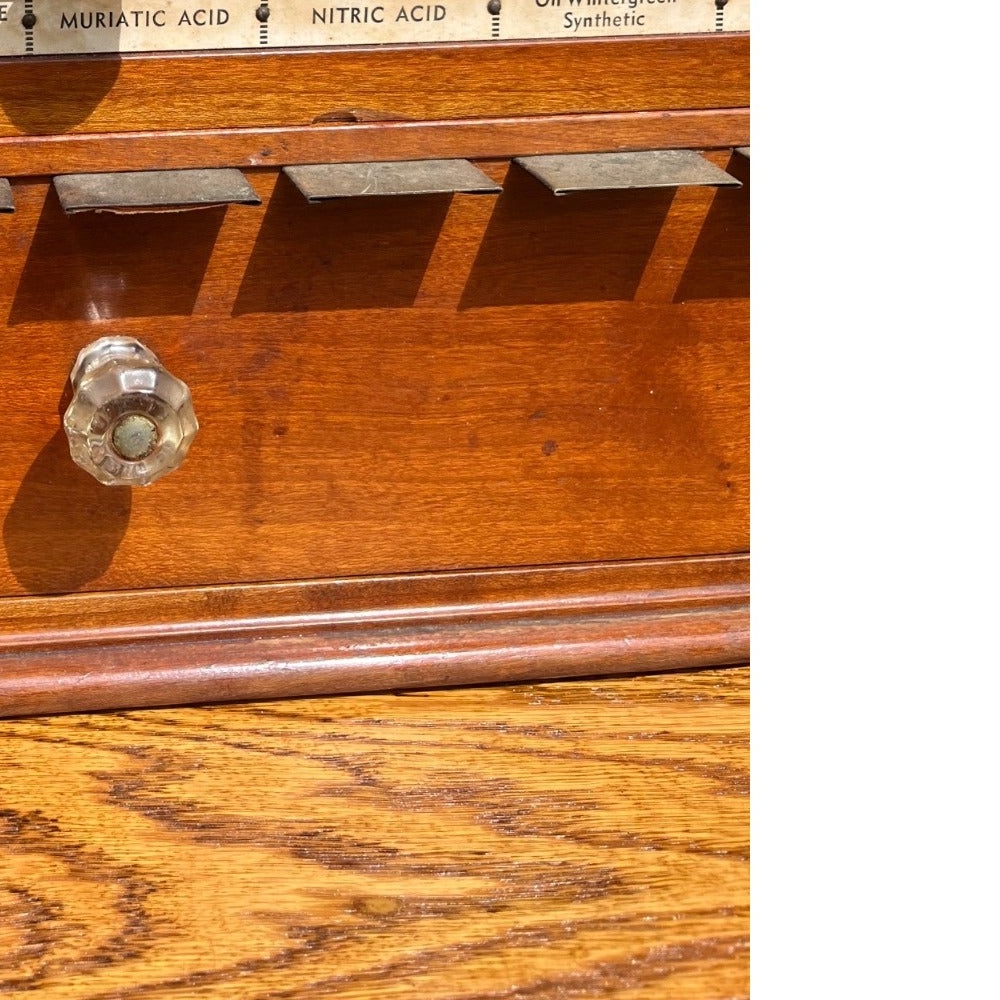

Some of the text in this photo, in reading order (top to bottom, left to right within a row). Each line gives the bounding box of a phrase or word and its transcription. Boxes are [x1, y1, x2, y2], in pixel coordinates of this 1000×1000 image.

[59, 8, 230, 30] MURIATIC ACID
[311, 4, 447, 25] NITRIC ACID
[563, 9, 646, 31] Synthetic
